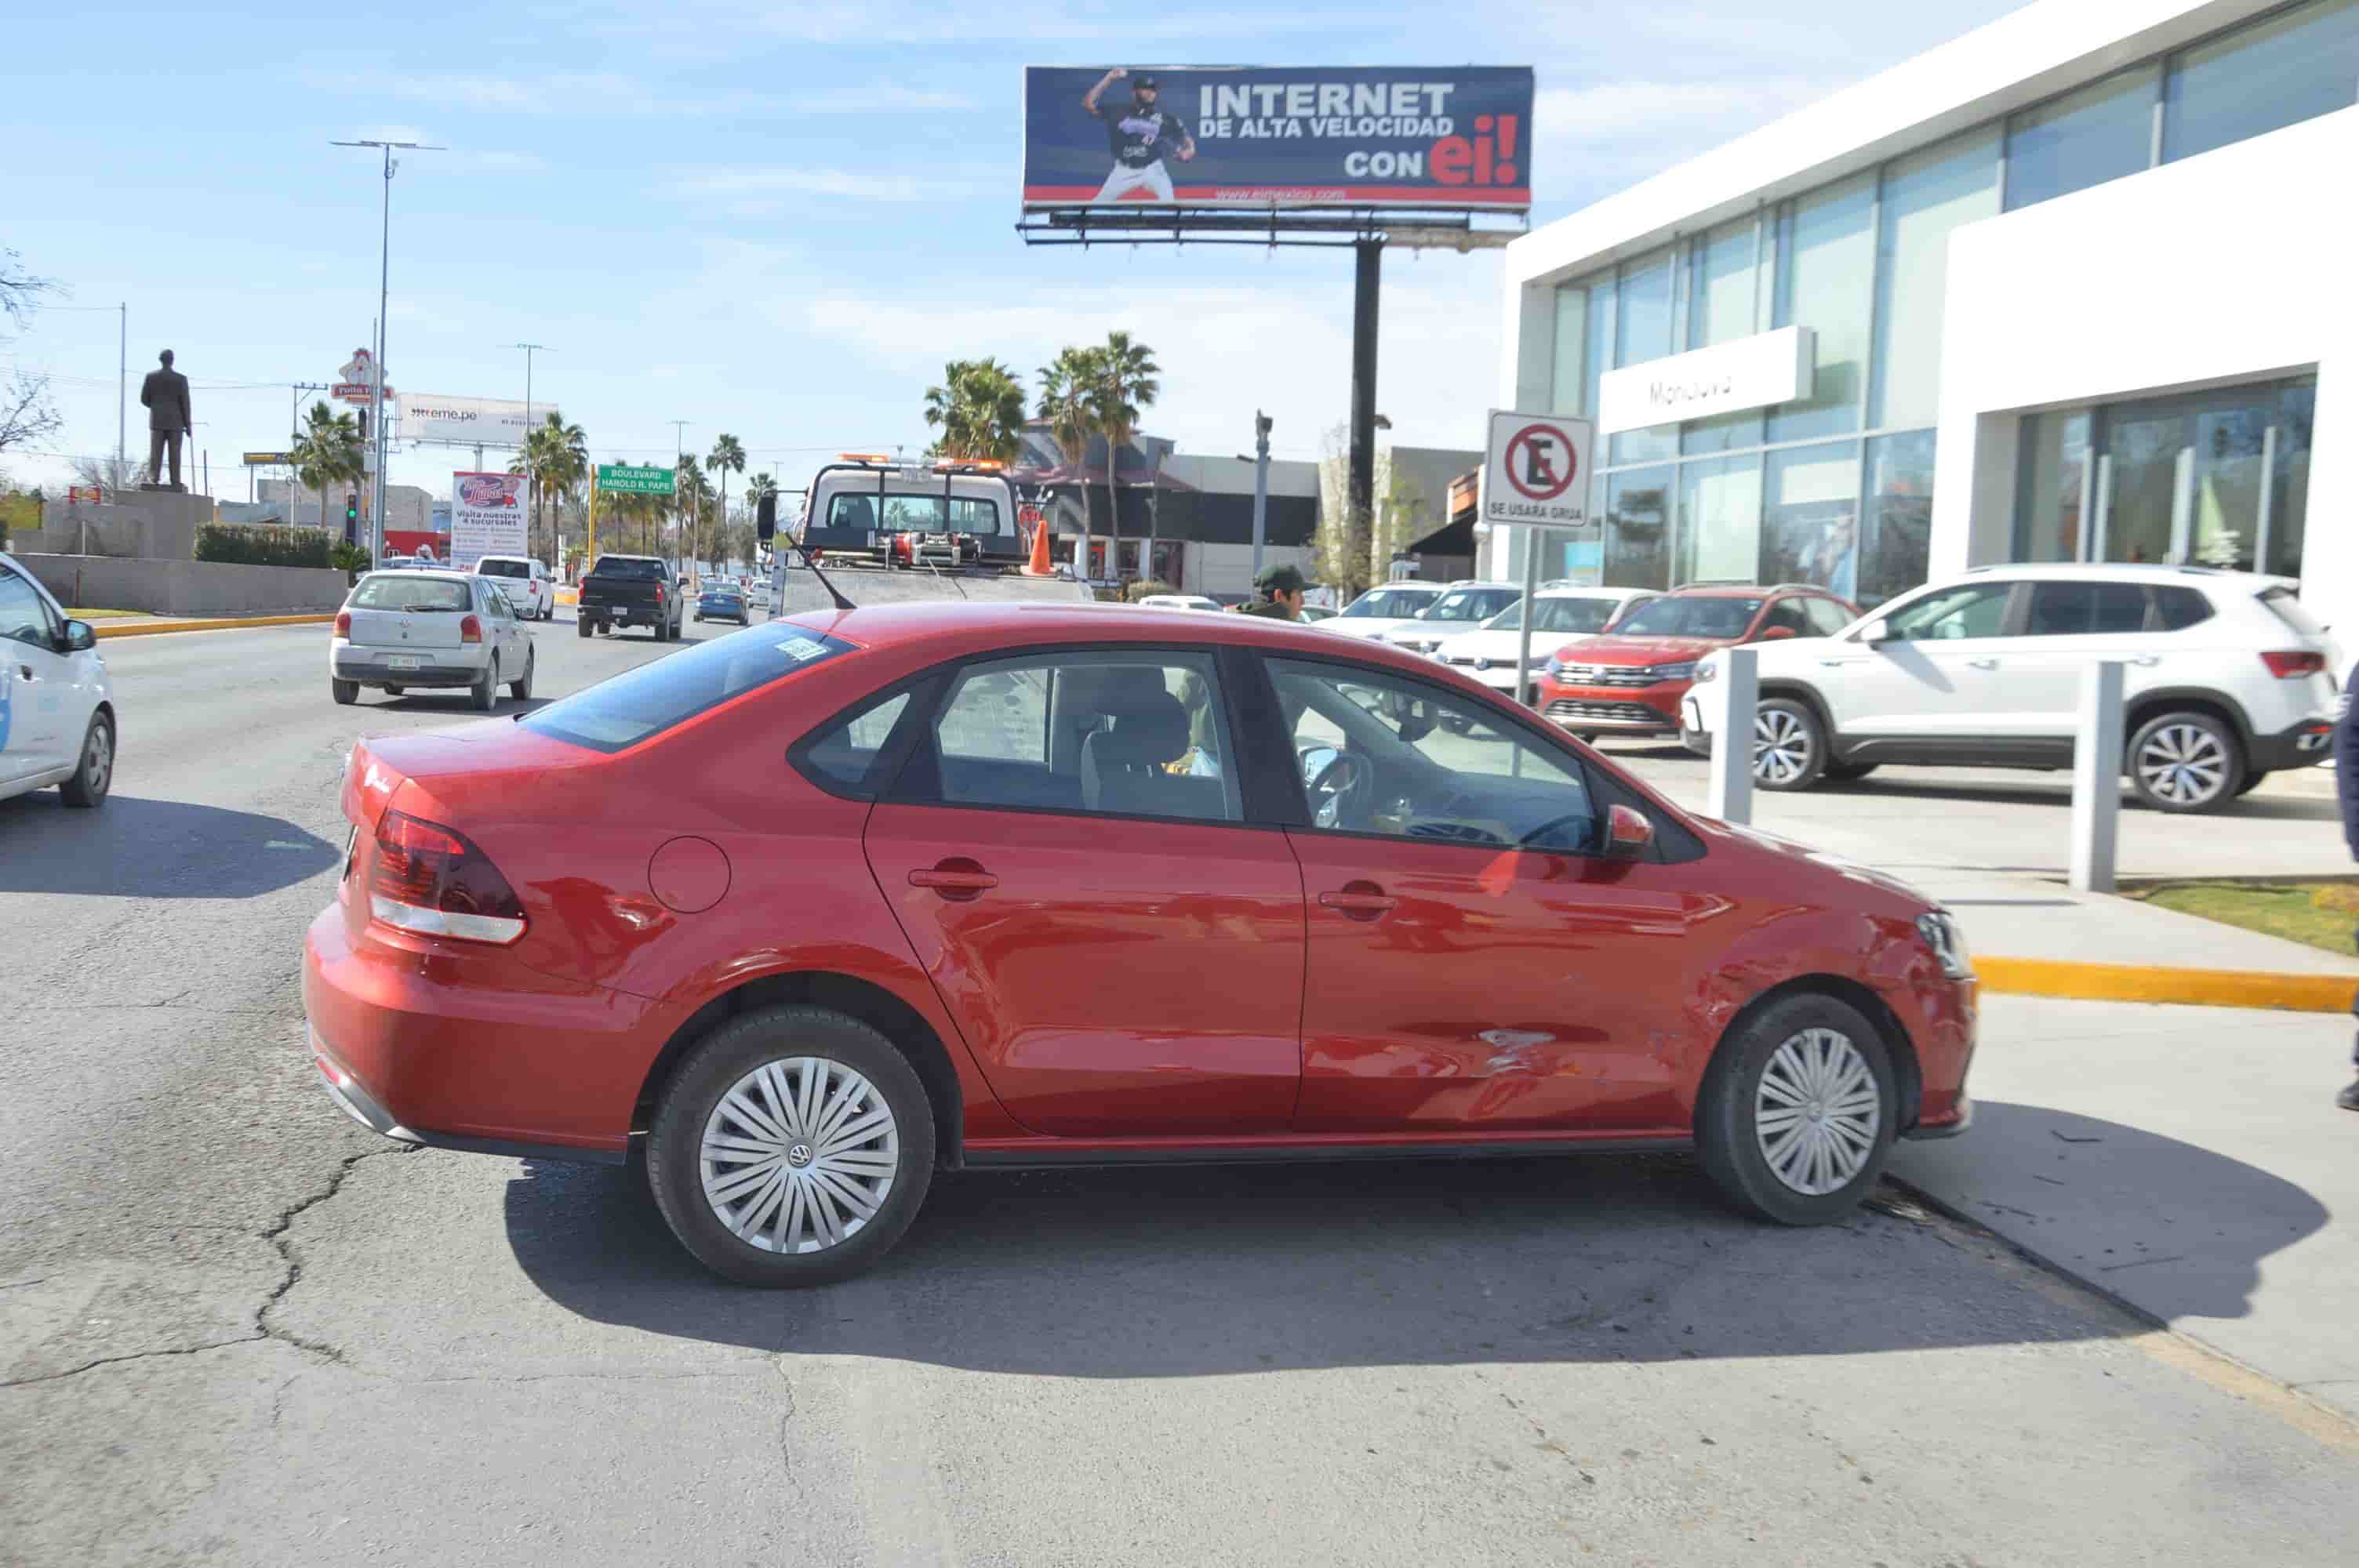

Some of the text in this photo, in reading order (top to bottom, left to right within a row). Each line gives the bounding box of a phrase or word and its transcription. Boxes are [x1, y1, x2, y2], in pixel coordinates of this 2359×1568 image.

[1199, 82, 1456, 118] INTERNET
[1198, 118, 1455, 139] DE ALTA VELOCIDAD
[1344, 114, 1519, 185] CON ei!
[611, 469, 661, 480] BOULEVARD
[602, 478, 637, 488] HAROLD
[649, 481, 670, 491] PAPE
[1490, 502, 1507, 514] SE
[456, 510, 522, 521] Visita nuestras
[471, 517, 518, 527] sucursales
